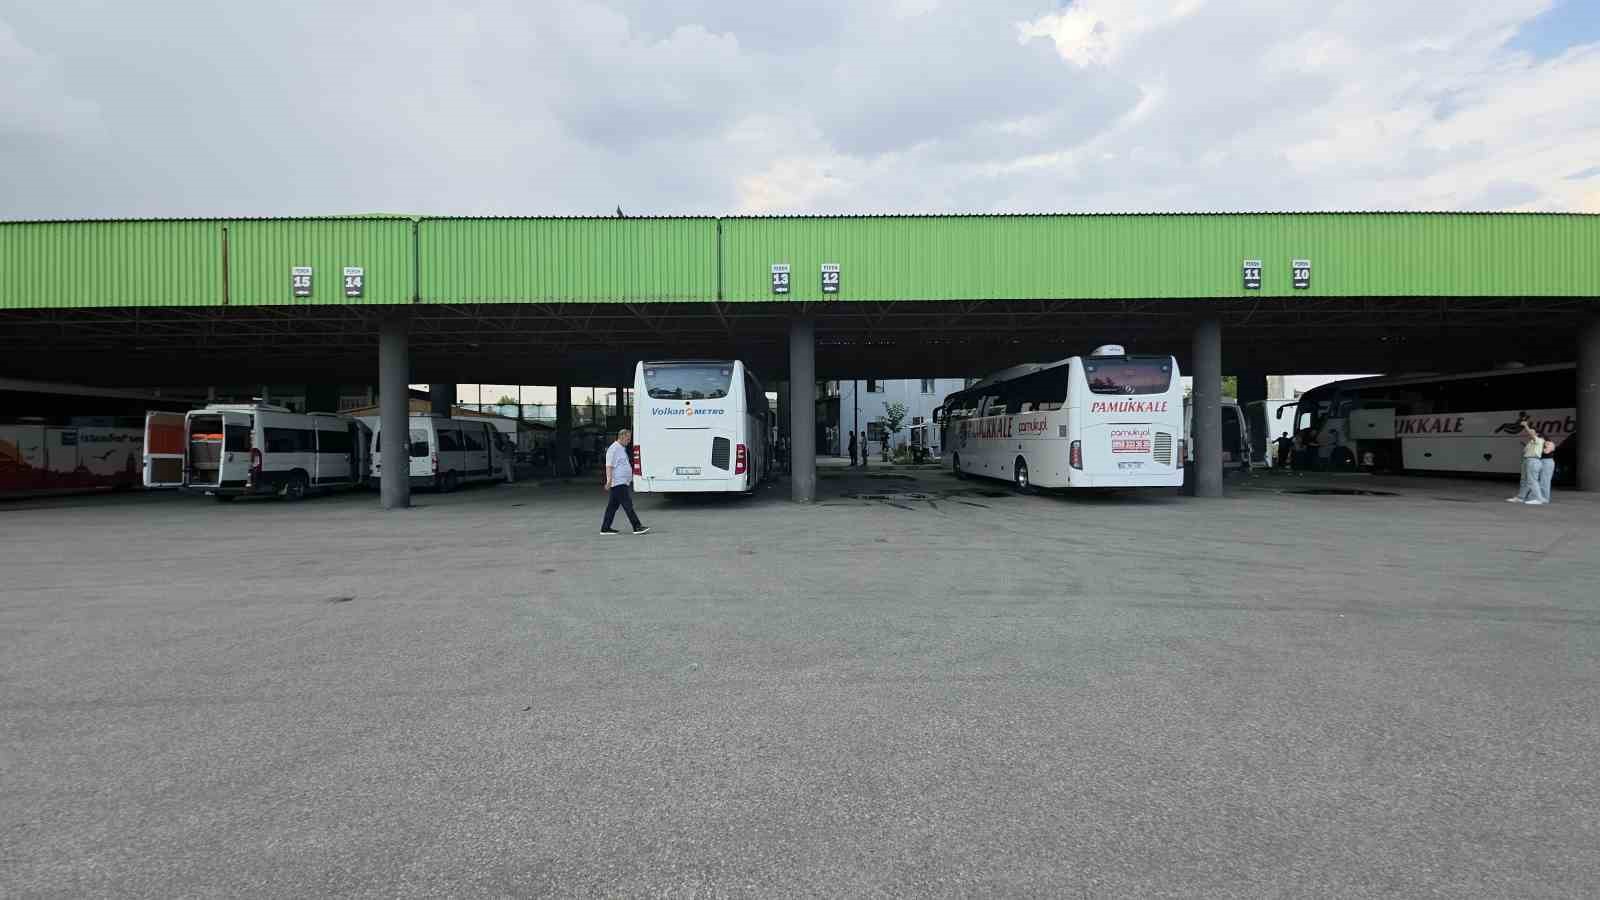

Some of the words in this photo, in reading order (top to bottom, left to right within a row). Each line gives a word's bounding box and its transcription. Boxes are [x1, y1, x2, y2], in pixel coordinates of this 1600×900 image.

[773, 273, 788, 285] 13
[823, 273, 838, 284] 12
[1245, 269, 1260, 280] 11
[1294, 269, 1309, 280] 10
[294, 276, 310, 287] 15
[345, 276, 362, 288] 14
[651, 407, 684, 416] Volkan
[1091, 401, 1168, 413] PAMUKKALE
